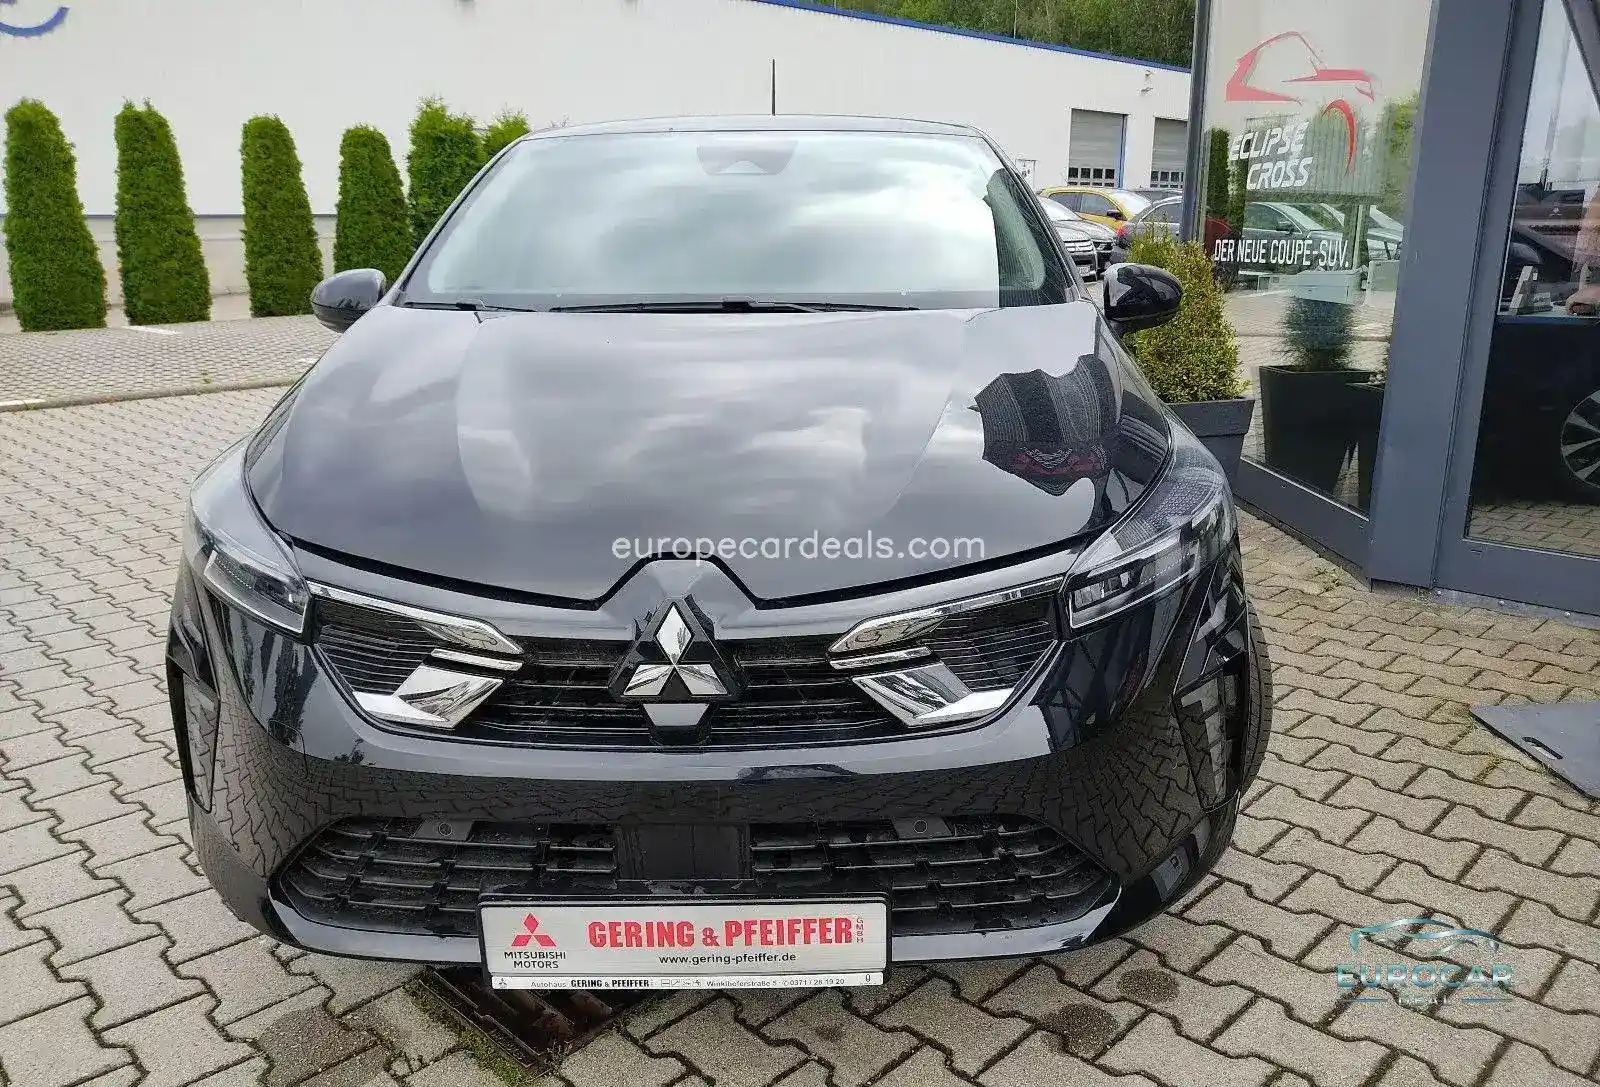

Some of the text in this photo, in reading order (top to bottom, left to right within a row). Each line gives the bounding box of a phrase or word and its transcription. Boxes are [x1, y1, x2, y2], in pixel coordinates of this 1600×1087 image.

[1229, 120, 1310, 160] ECLIPSE
[1246, 156, 1313, 190] CROSS
[1214, 239, 1235, 262] DER
[1237, 239, 1268, 263] NEUE
[588, 917, 853, 948] GERING & PFEIFFER
[504, 951, 566, 960] MITSUBISHI
[513, 960, 559, 969] MOTORS
[658, 952, 797, 966] www.gering-pfeiffer.de
[530, 980, 567, 988] Autohaus
[570, 979, 603, 988] GERING
[611, 979, 650, 988] PFEIFFER
